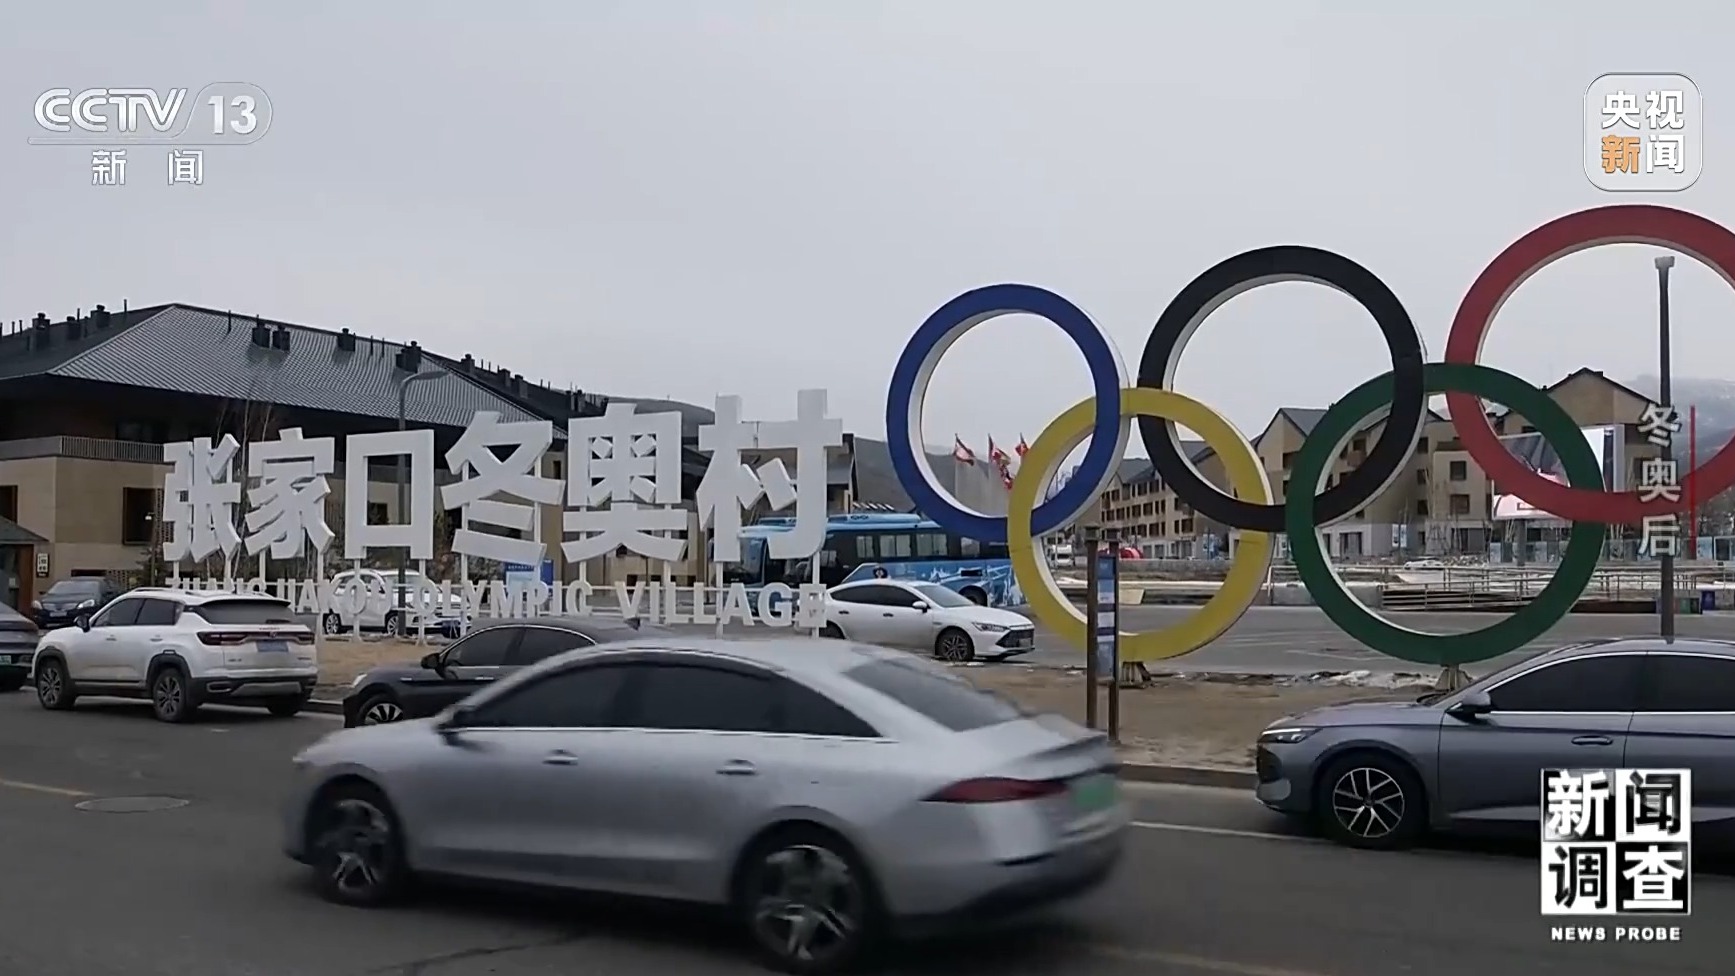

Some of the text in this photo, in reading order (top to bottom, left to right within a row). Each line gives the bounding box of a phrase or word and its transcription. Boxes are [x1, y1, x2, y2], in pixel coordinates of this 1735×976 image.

[163, 389, 843, 563] 张家口冬奥村
[413, 578, 594, 618] OLYMPIC
[615, 580, 828, 628] VILLAGE
